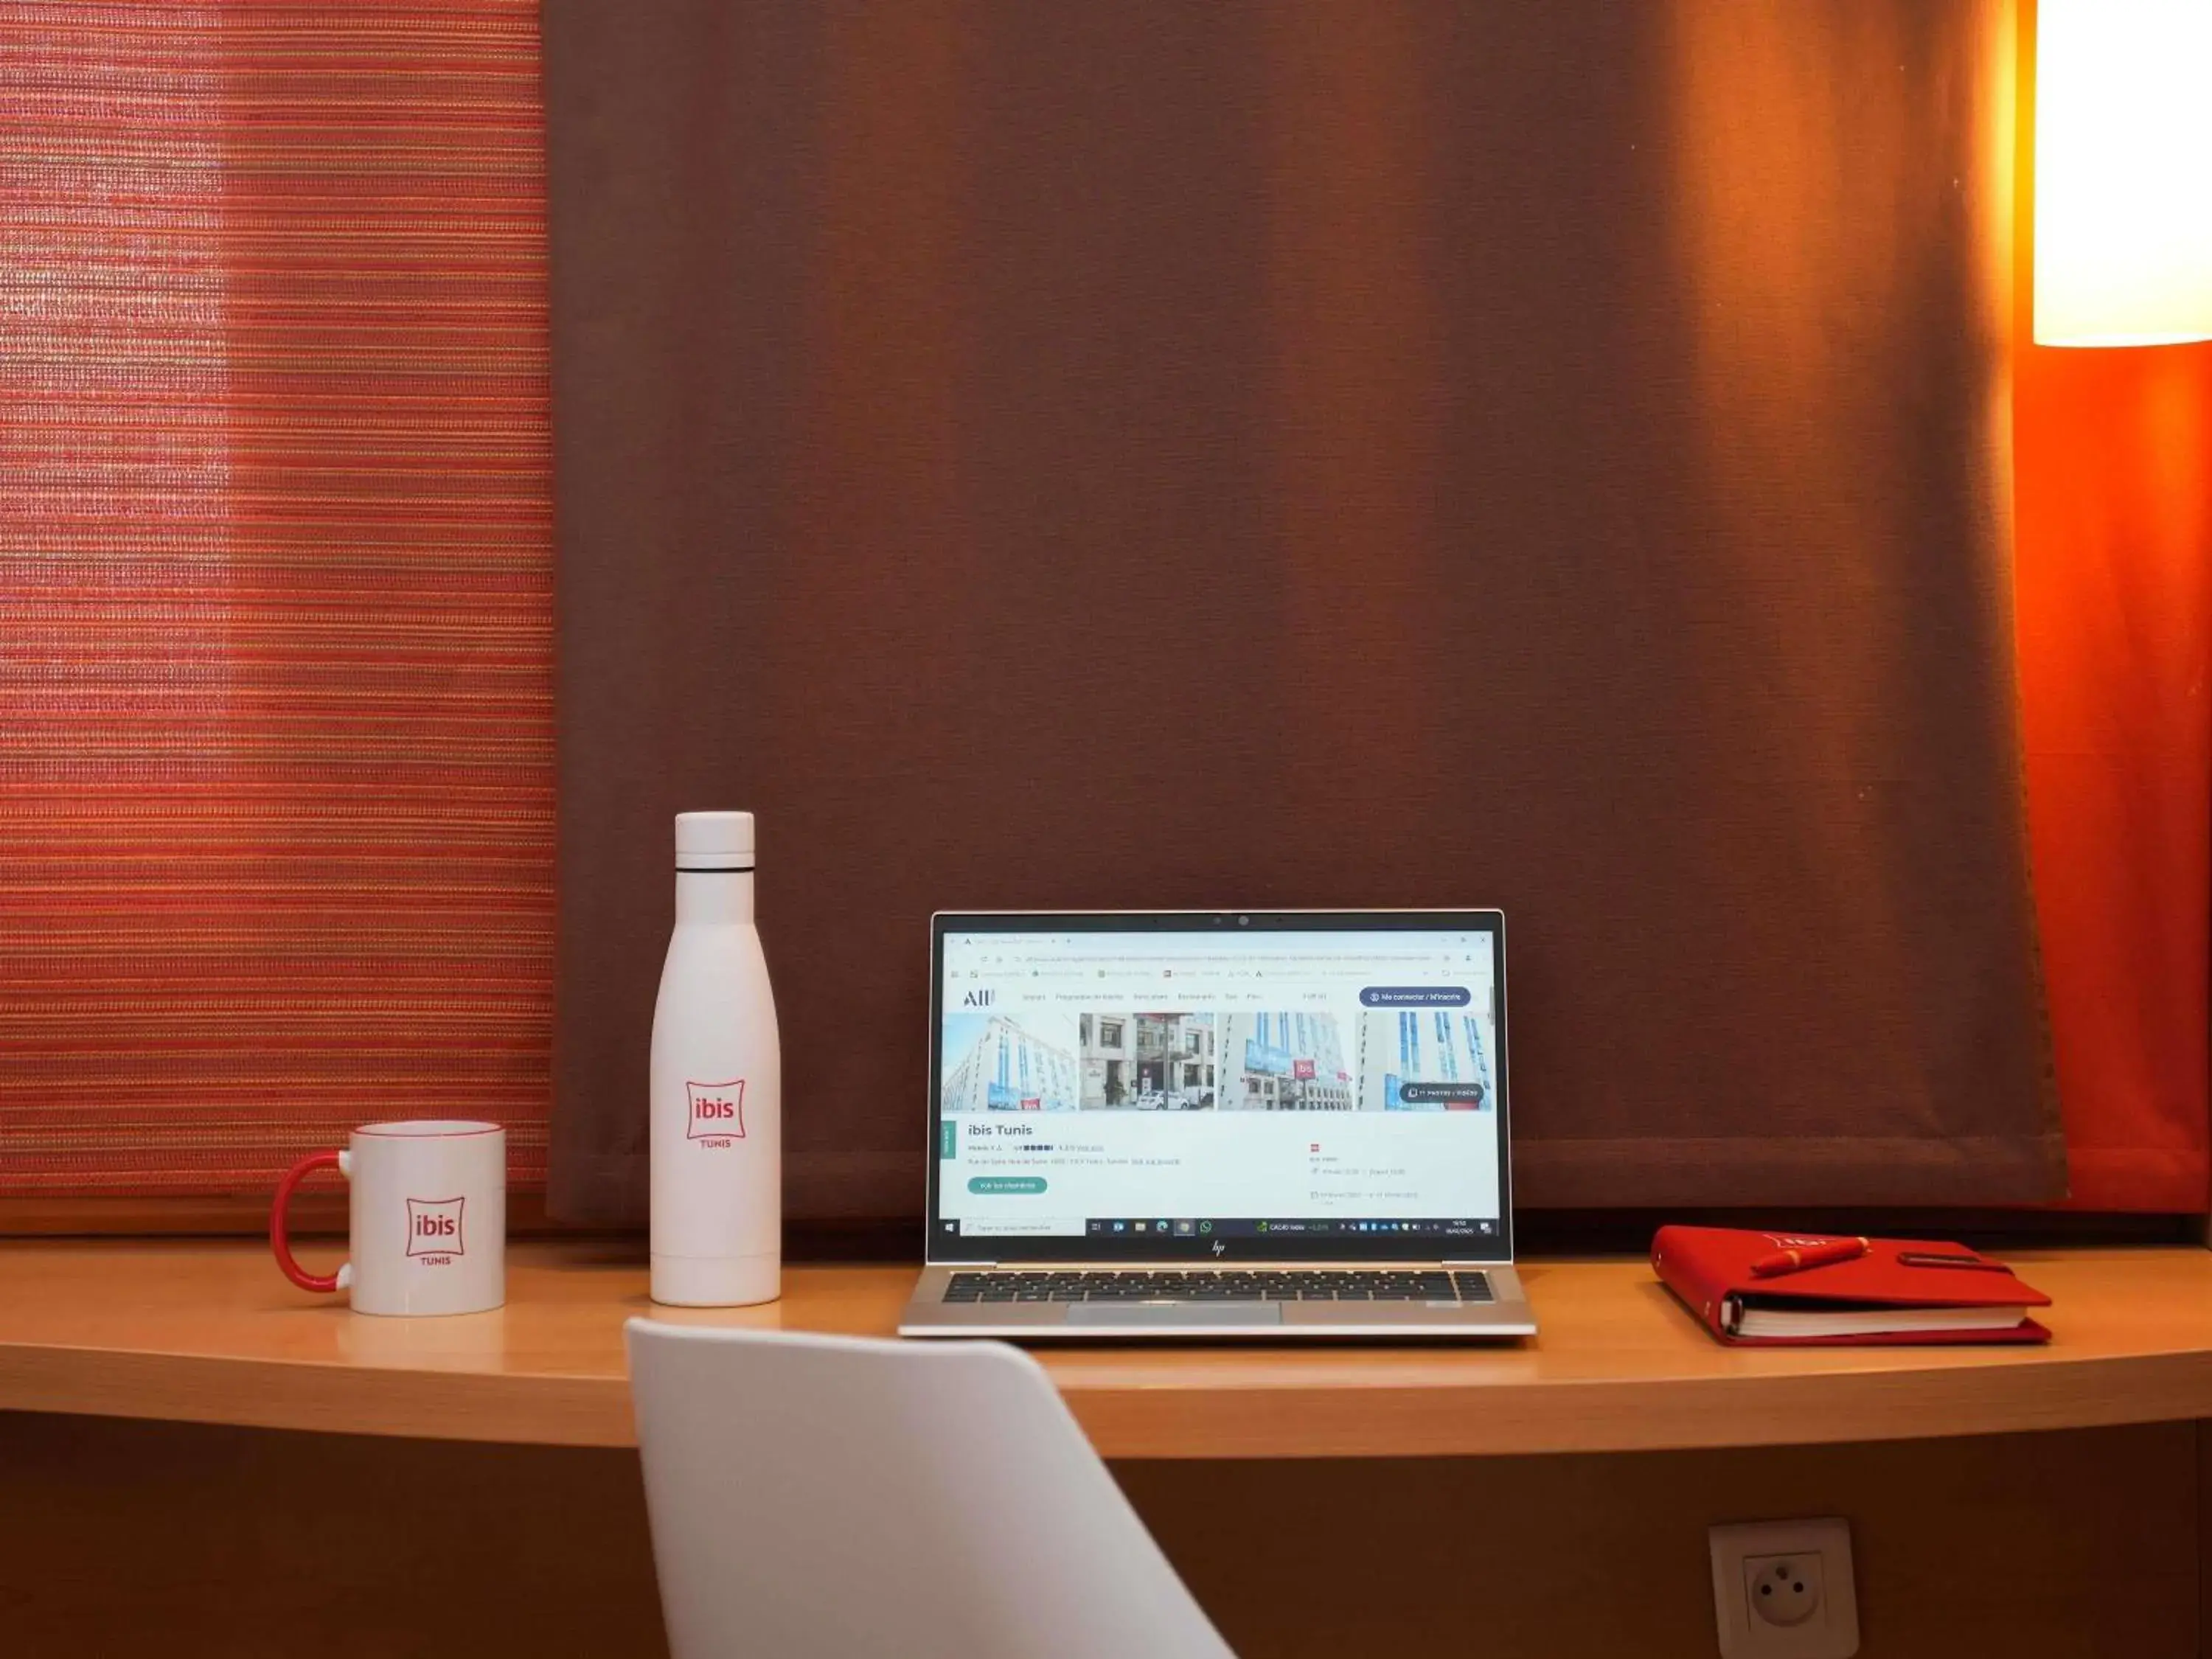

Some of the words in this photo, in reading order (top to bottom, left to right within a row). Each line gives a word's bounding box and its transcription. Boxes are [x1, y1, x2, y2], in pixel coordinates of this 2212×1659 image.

[695, 1097, 734, 1119] ibis
[968, 1124, 992, 1135] ibis
[995, 1124, 1033, 1135] Tunis
[700, 1139, 731, 1149] TUNIS
[416, 1214, 455, 1236] ibis
[421, 1256, 451, 1265] TUNIS
